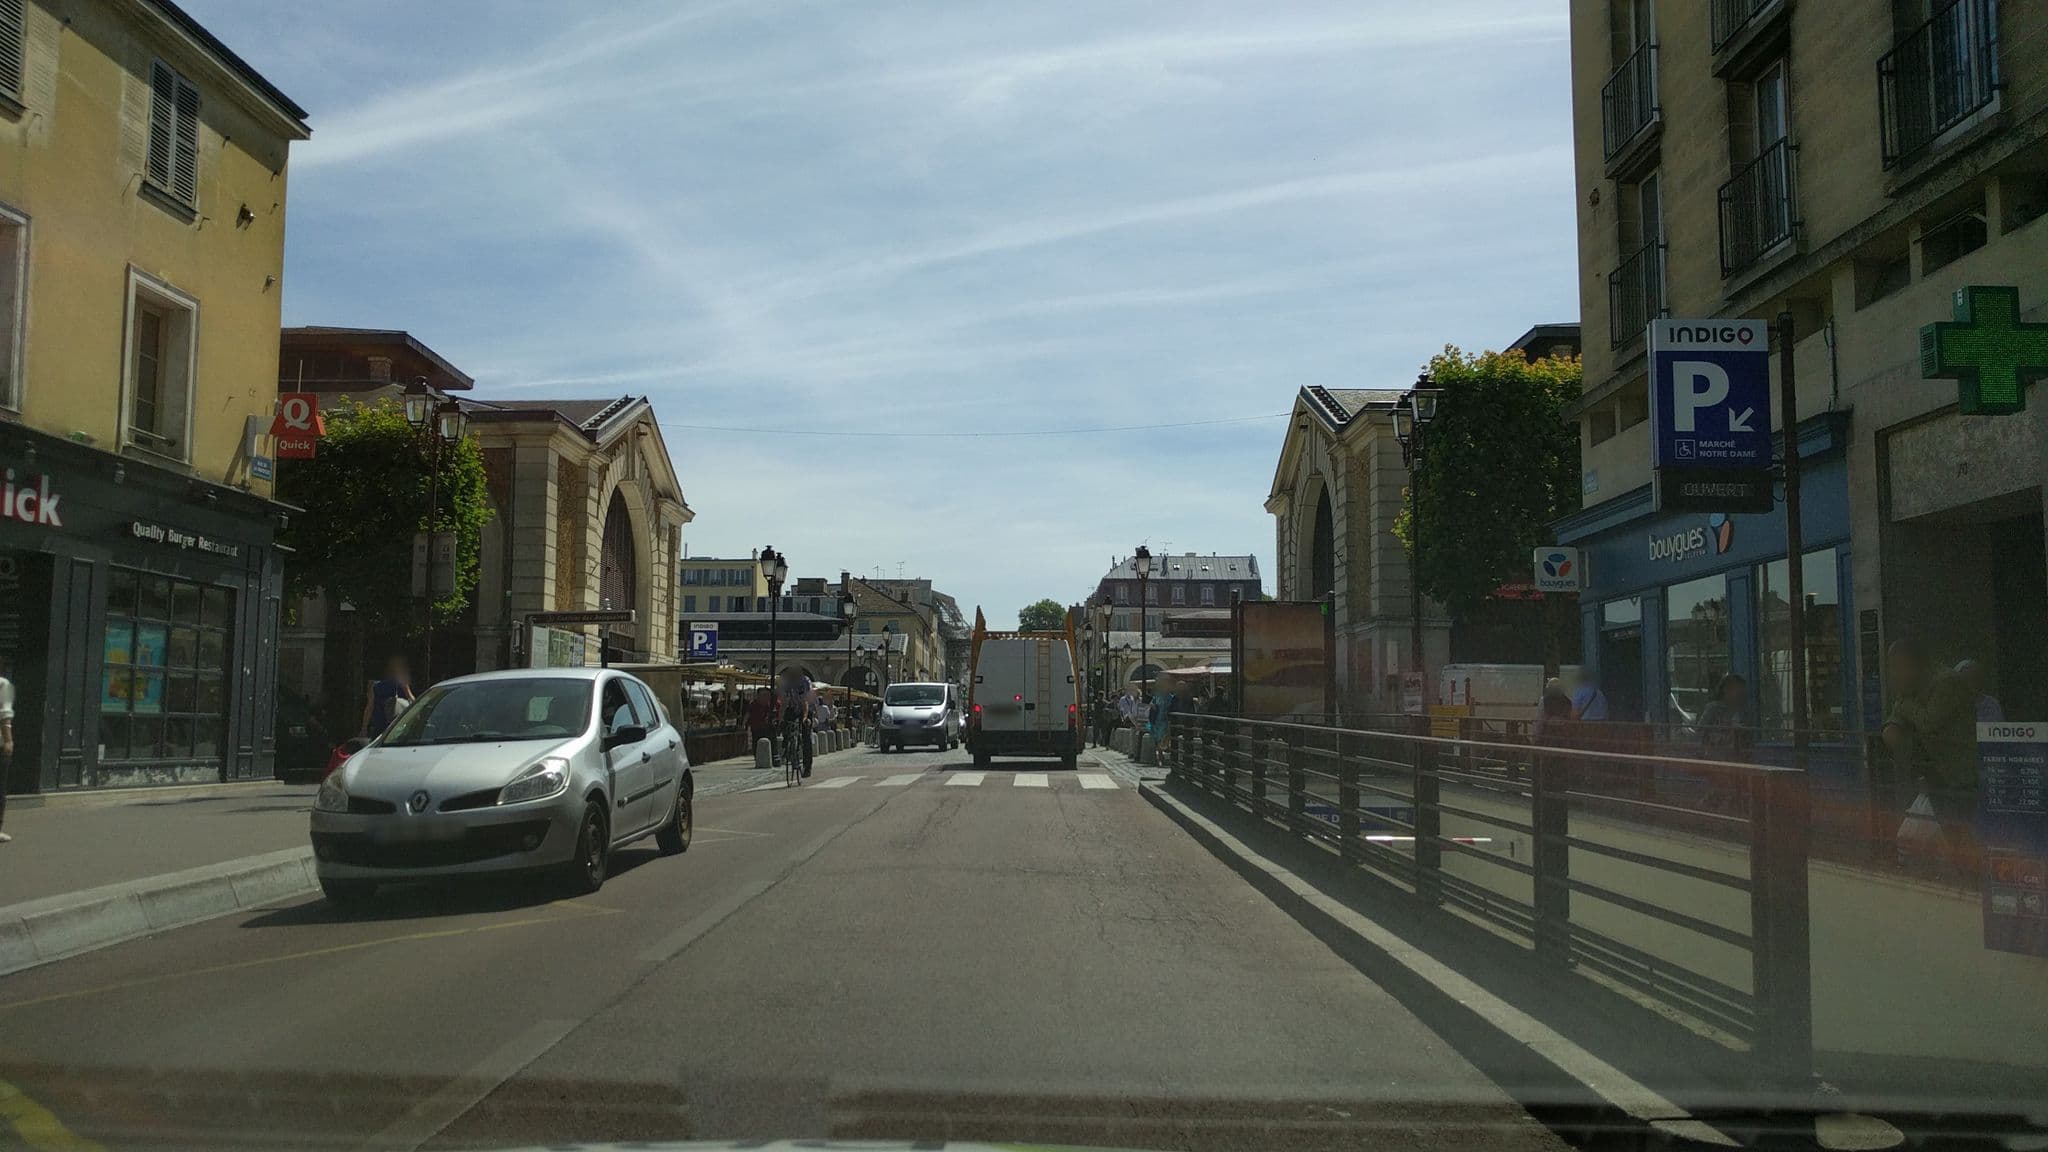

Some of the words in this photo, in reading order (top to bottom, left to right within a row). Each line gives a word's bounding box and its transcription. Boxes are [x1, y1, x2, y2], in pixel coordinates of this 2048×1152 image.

[1669, 327, 1754, 345] INDIGO
[1673, 361, 1730, 432] P
[283, 398, 310, 431] Q
[280, 440, 311, 450] Quick
[1699, 440, 1737, 449] MARCHÉ
[1699, 450, 1728, 459] NOTRE
[1731, 450, 1755, 459] DAME
[133, 521, 165, 542] Quality
[168, 529, 195, 550] Burger
[198, 536, 239, 557] Restaurant
[1648, 528, 1704, 561] bouygues
[693, 632, 708, 650] P
[1988, 727, 2035, 738] INDIGO
